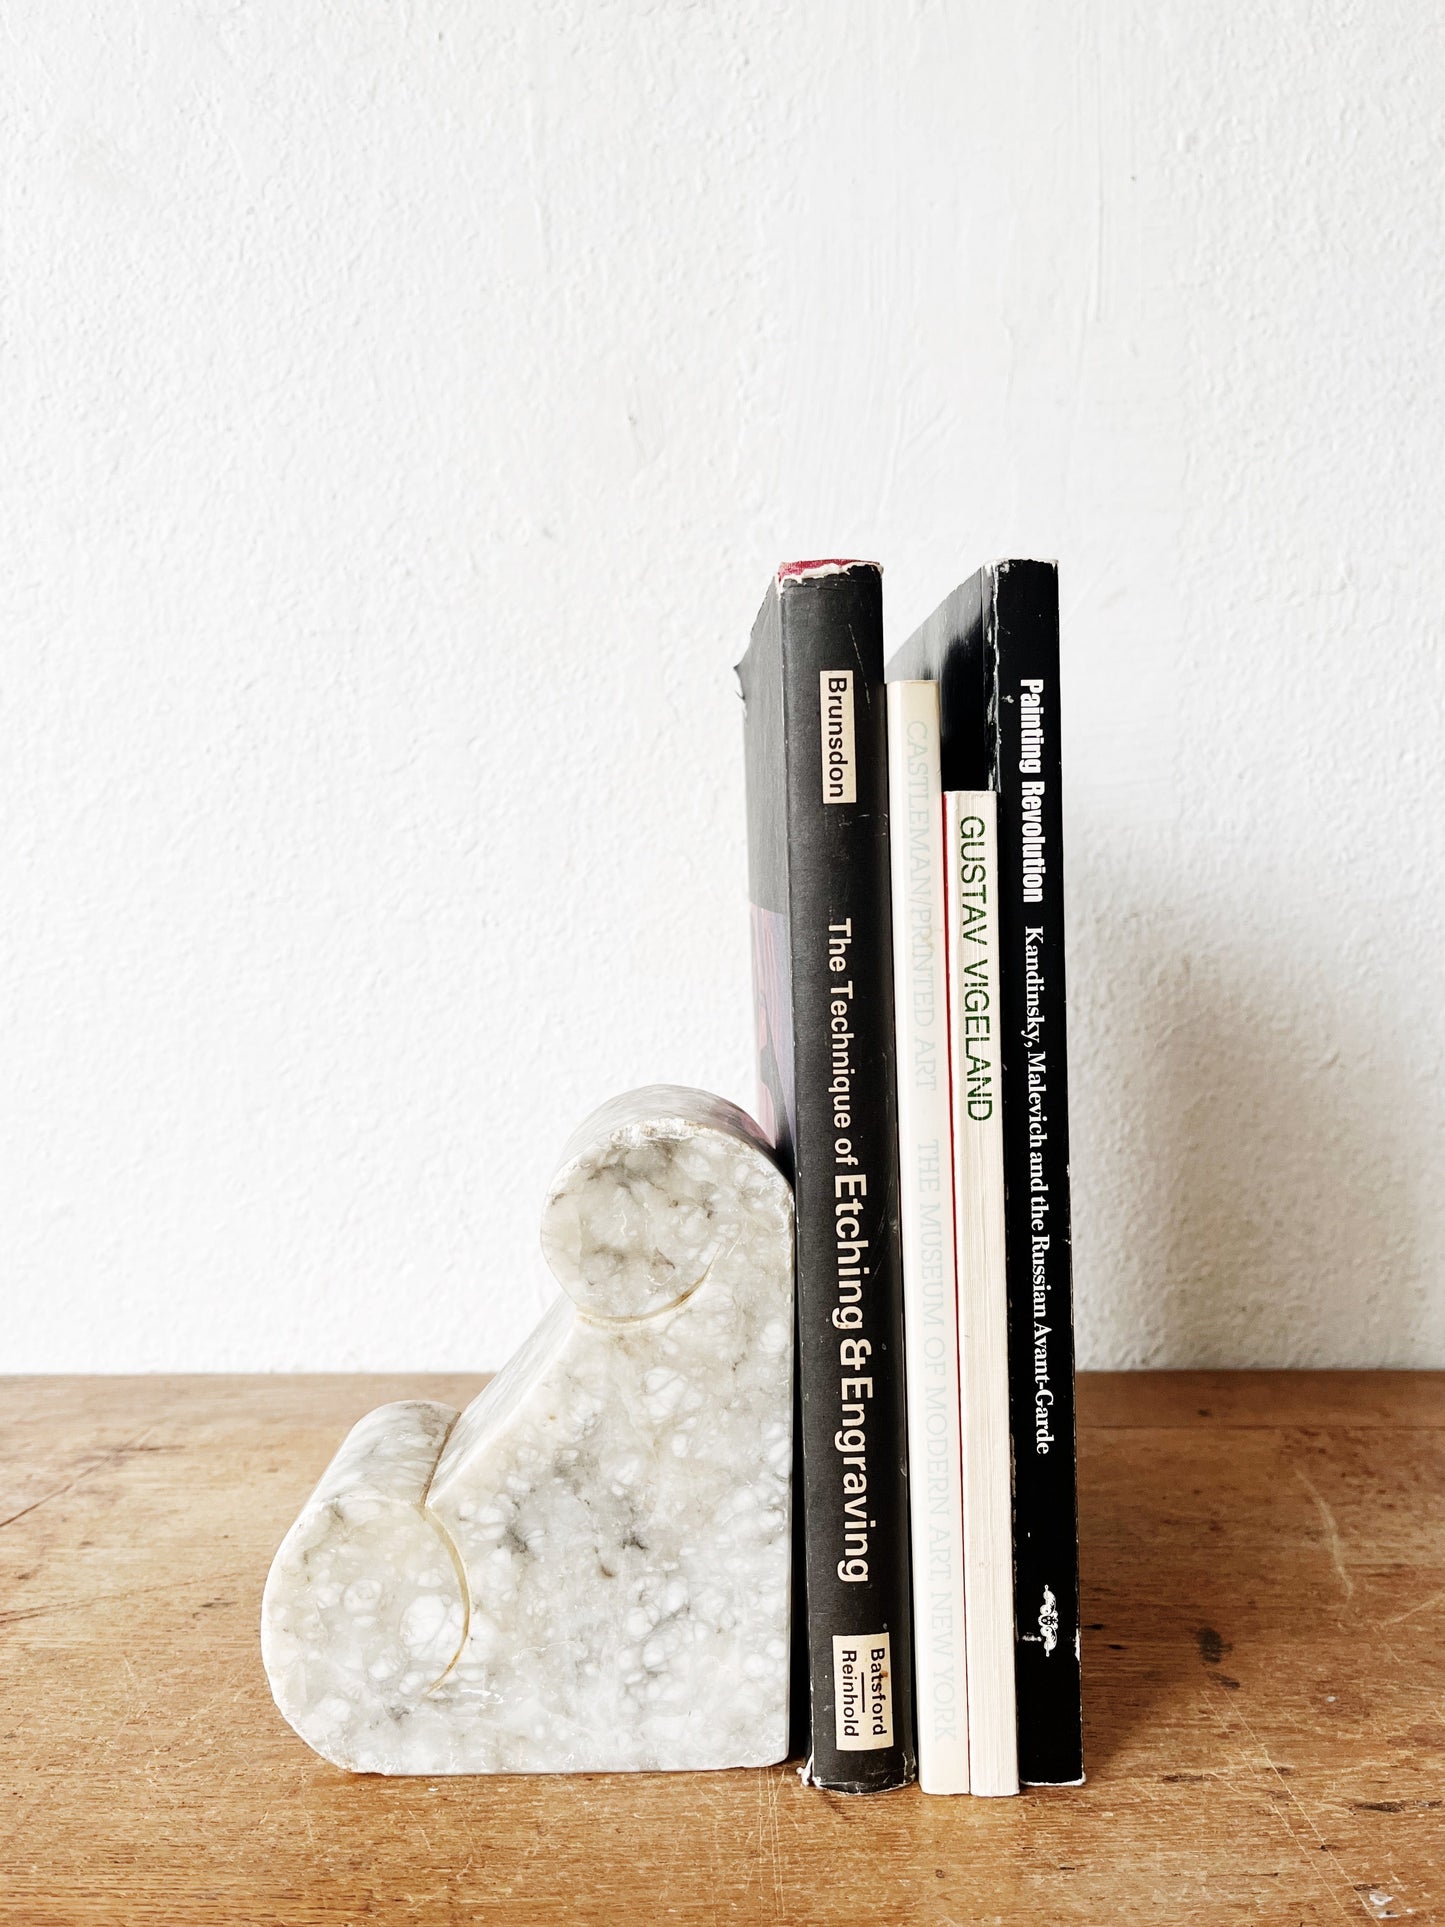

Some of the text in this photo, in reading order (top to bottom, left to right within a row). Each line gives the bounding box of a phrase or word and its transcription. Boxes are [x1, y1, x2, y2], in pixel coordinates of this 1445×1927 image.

[827, 677, 849, 798] Brunsdon
[1019, 679, 1047, 903] Painting Revolution
[913, 1037, 937, 1091] ART
[959, 816, 993, 1121] GUSTAV VIGELAND
[828, 918, 877, 1583] The Technique of Etching & Engraving
[1021, 926, 1055, 1455] Kandinsky, Malevich and the Russian Avant-Garde
[918, 1139, 958, 1742] THE MUSEUM OF MODERN ART NEW YORK
[842, 1650, 860, 1737] Reinhold
[869, 1647, 887, 1736] Batsford
